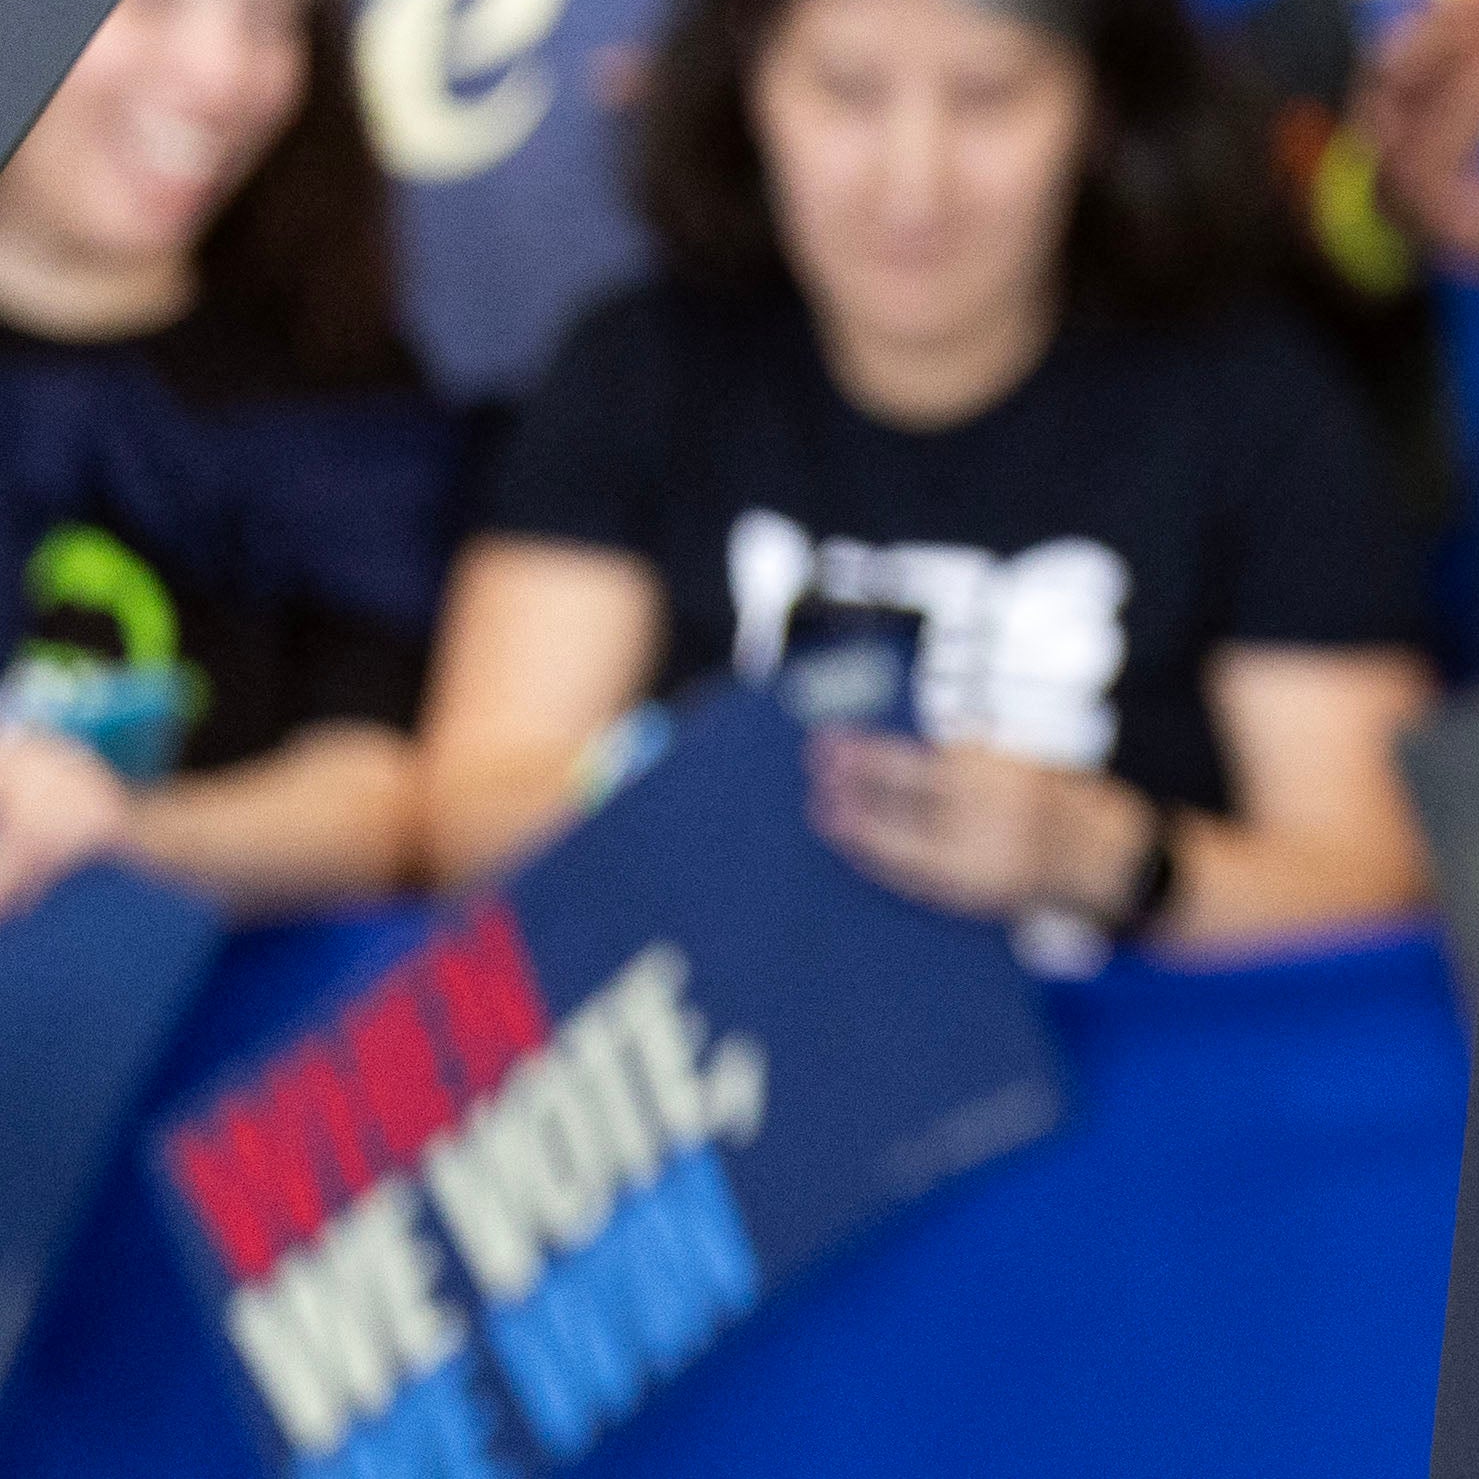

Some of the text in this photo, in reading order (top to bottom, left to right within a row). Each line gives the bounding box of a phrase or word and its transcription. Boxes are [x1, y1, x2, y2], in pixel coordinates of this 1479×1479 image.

[168, 892, 550, 1286] WHEN
[230, 940, 768, 1458] WE VOTE,
